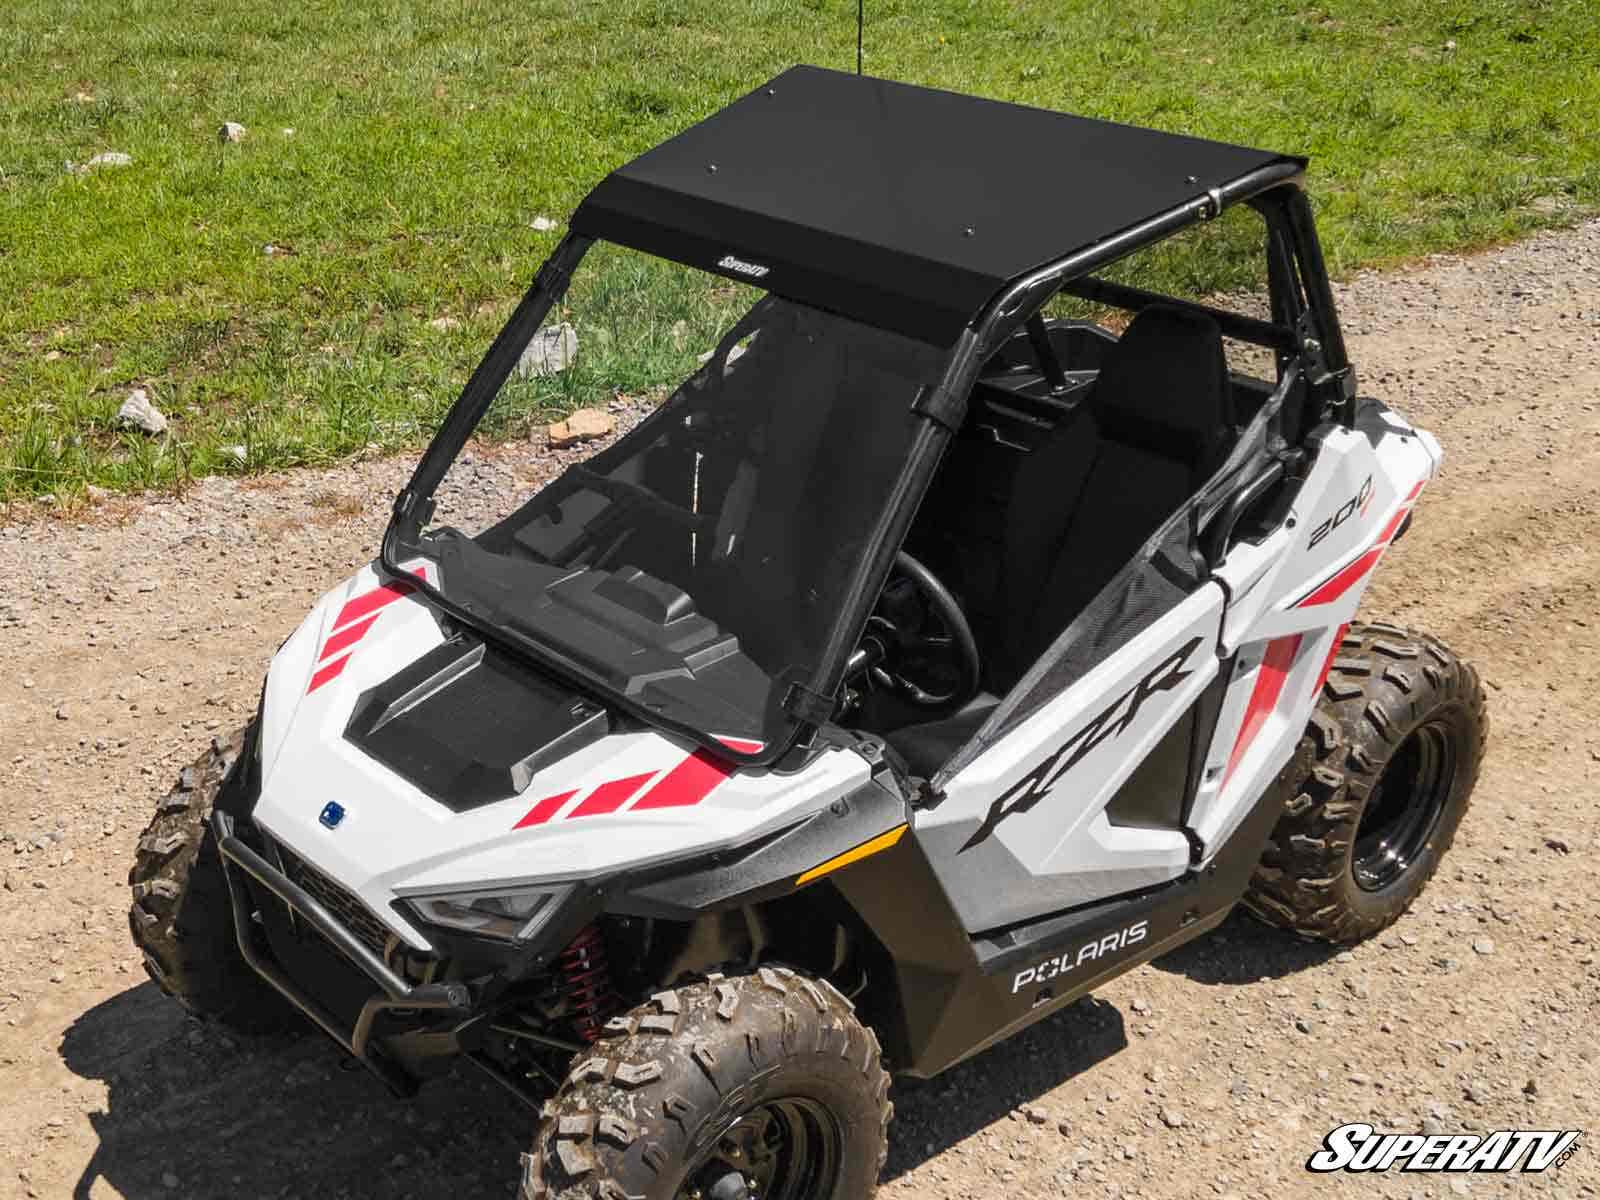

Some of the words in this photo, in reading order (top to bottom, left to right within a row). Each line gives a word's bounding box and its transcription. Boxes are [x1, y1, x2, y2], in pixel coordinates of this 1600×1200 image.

[1306, 474, 1373, 551] 200
[956, 637, 1204, 855] RZR
[1012, 920, 1148, 993] POLARIS
